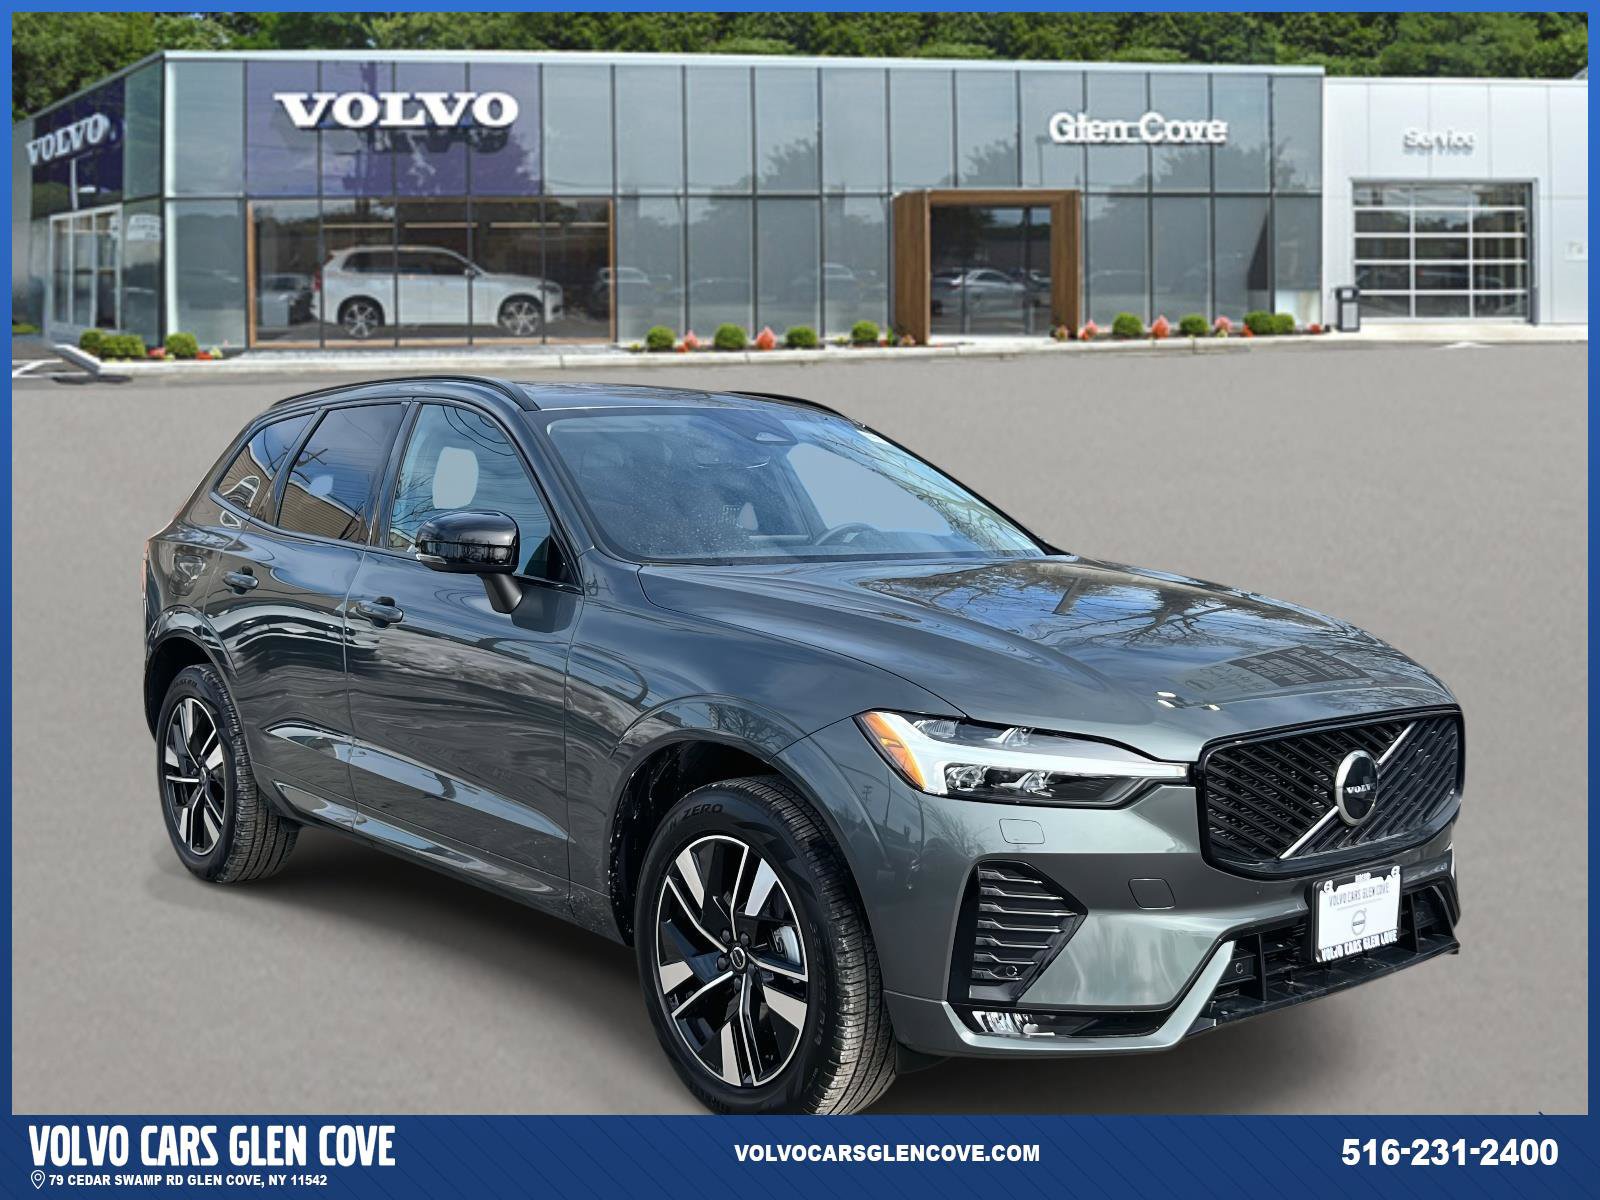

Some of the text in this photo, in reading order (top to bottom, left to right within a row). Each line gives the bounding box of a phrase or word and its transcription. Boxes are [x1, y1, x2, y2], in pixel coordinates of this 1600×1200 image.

[274, 92, 519, 128] VOLVO
[26, 112, 110, 165] VOLVO
[1049, 112, 1228, 143] Glen Cove
[1403, 129, 1475, 154] Service
[684, 803, 724, 818] ZERO
